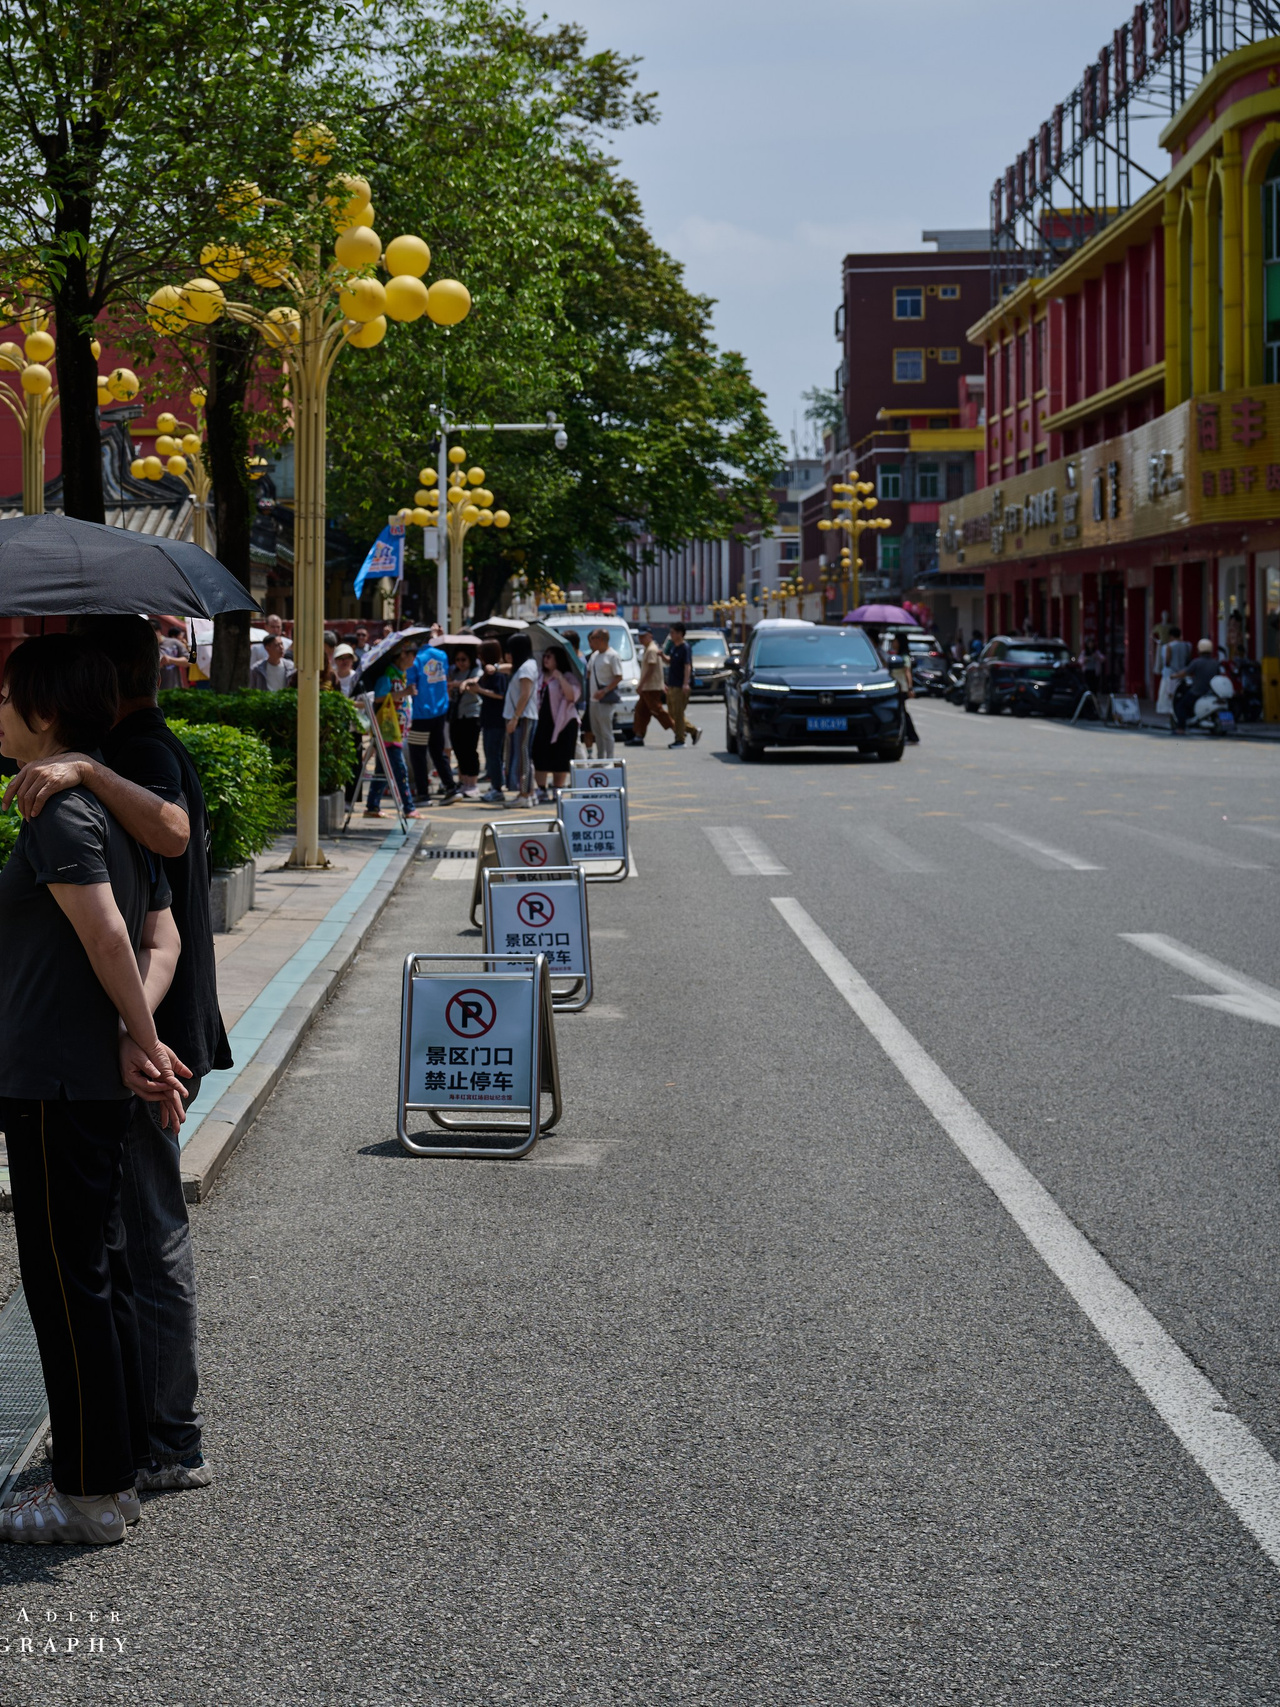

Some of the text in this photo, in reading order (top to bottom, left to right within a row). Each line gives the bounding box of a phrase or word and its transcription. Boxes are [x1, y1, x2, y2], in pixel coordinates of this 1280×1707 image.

[572, 830, 615, 841] 景区门口
[572, 842, 616, 852] 禁止停车
[505, 932, 570, 948] 景区门口
[425, 1046, 513, 1066] 景区门口
[424, 1071, 514, 1092] 禁止停车
